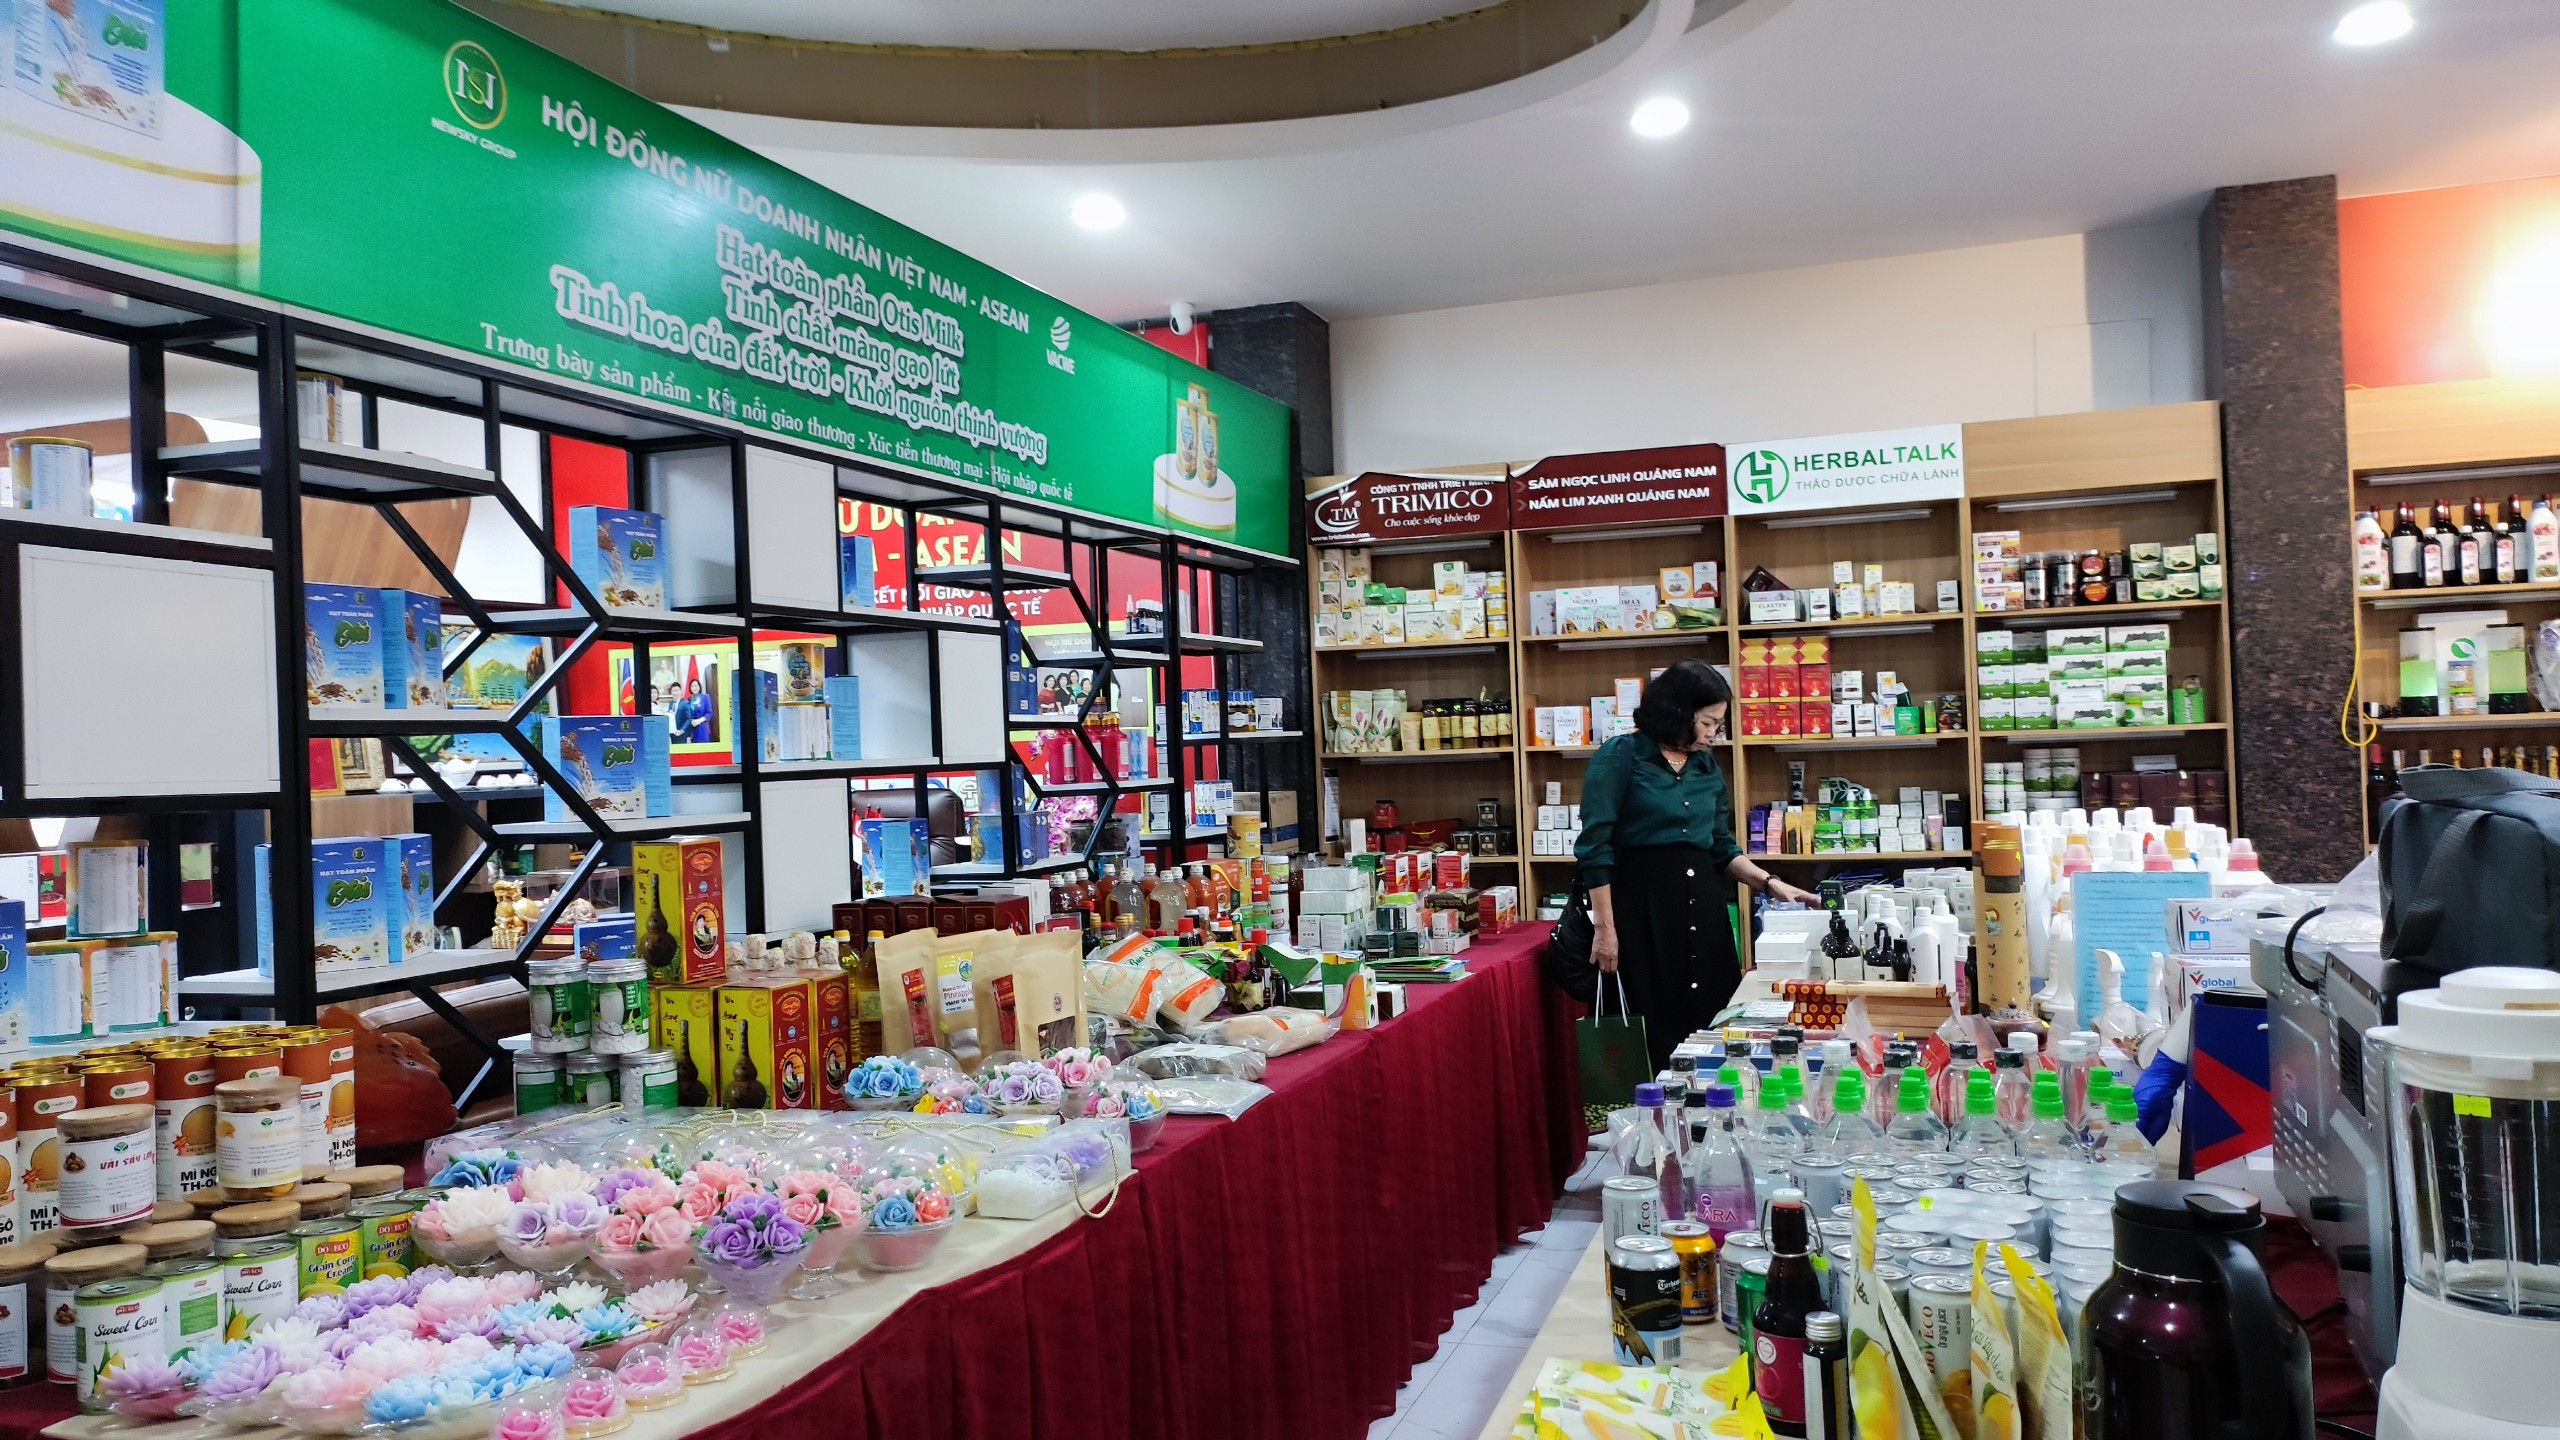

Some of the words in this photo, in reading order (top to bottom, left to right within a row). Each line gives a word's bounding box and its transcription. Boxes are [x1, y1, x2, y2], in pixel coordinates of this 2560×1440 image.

[480, 138, 517, 159] GROUP
[542, 95, 597, 148] HỘI
[604, 128, 688, 187] ĐỒNG
[694, 166, 733, 199] NỮ
[737, 185, 820, 245] DOANH
[825, 224, 882, 272] NHÂN
[885, 251, 926, 291] VIỆT
[929, 271, 967, 308] NAM
[979, 295, 1030, 334] ASEAN
[717, 227, 767, 281] Hạt
[770, 250, 823, 301] toàn
[826, 275, 877, 323] phần
[882, 296, 921, 337] Otis
[924, 312, 963, 353] Milk
[786, 305, 833, 348] chất
[836, 329, 893, 374] màng
[897, 353, 931, 385] gạo
[633, 296, 687, 349] hoa
[694, 322, 738, 364] của
[745, 335, 784, 378] đất
[788, 353, 829, 392] trời
[848, 367, 894, 412] Khởi
[898, 390, 953, 428] nguồn
[956, 404, 998, 445] thịnh
[1000, 424, 1046, 462] vượng
[480, 321, 549, 370] Trưng
[556, 343, 594, 381] bày
[599, 360, 635, 389] sản
[640, 371, 691, 404] phẩm
[741, 396, 768, 423] nối
[770, 407, 803, 432] giao
[807, 416, 856, 449] thương
[867, 431, 893, 456] Xúc
[895, 438, 919, 462] tiến
[921, 447, 961, 476] thương
[963, 462, 983, 482] mại
[990, 465, 1011, 487] Hội
[1013, 470, 1037, 495] nhập
[1039, 478, 1061, 499] quốc
[1063, 483, 1073, 502] tế
[1793, 441, 1957, 473] HERBALTALK
[1528, 477, 1559, 490] SÂM
[1561, 474, 1599, 488] NGỌC
[1600, 472, 1631, 485] LINH
[1633, 466, 1682, 483] QUẢNG
[1684, 465, 1717, 478] NAM
[1795, 478, 1831, 491] THẢO
[1835, 474, 1876, 488] DƯỢC
[1881, 470, 1919, 484] CHỮA
[1923, 467, 1959, 481] LÀNH
[1370, 484, 1398, 495] CÔNG
[1399, 483, 1411, 493] TY
[1411, 481, 1438, 491] TNHH
[1371, 488, 1493, 516] TRIMICO
[1529, 496, 1560, 510] NẤM
[1561, 496, 1585, 508] LIM
[1587, 493, 1624, 506] XANH
[1626, 488, 1675, 504] QUẢNG
[1677, 486, 1710, 500] NAM
[1384, 518, 1401, 528] Cho
[1402, 516, 1422, 527] cuộc
[1423, 513, 1443, 527] sống
[1464, 512, 1480, 524] đẹp
[968, 600, 1018, 617] QUC
[181, 1167, 197, 1182] MÌ
[200, 1166, 217, 1180] NG
[180, 1178, 218, 1193] TH-O
[30, 1206, 48, 1220] MÌ
[30, 1219, 59, 1231] TH-
[378, 1221, 408, 1234] DOECO
[316, 1241, 349, 1255] DOECO
[370, 1241, 395, 1252] Grain
[308, 1261, 334, 1273] Grain
[335, 1255, 356, 1268] Corn
[326, 1264, 355, 1279] Cream
[224, 1280, 253, 1295] Sweet
[257, 1278, 282, 1292] Corn
[94, 1319, 131, 1338] Sweet
[134, 1315, 158, 1331] Corn
